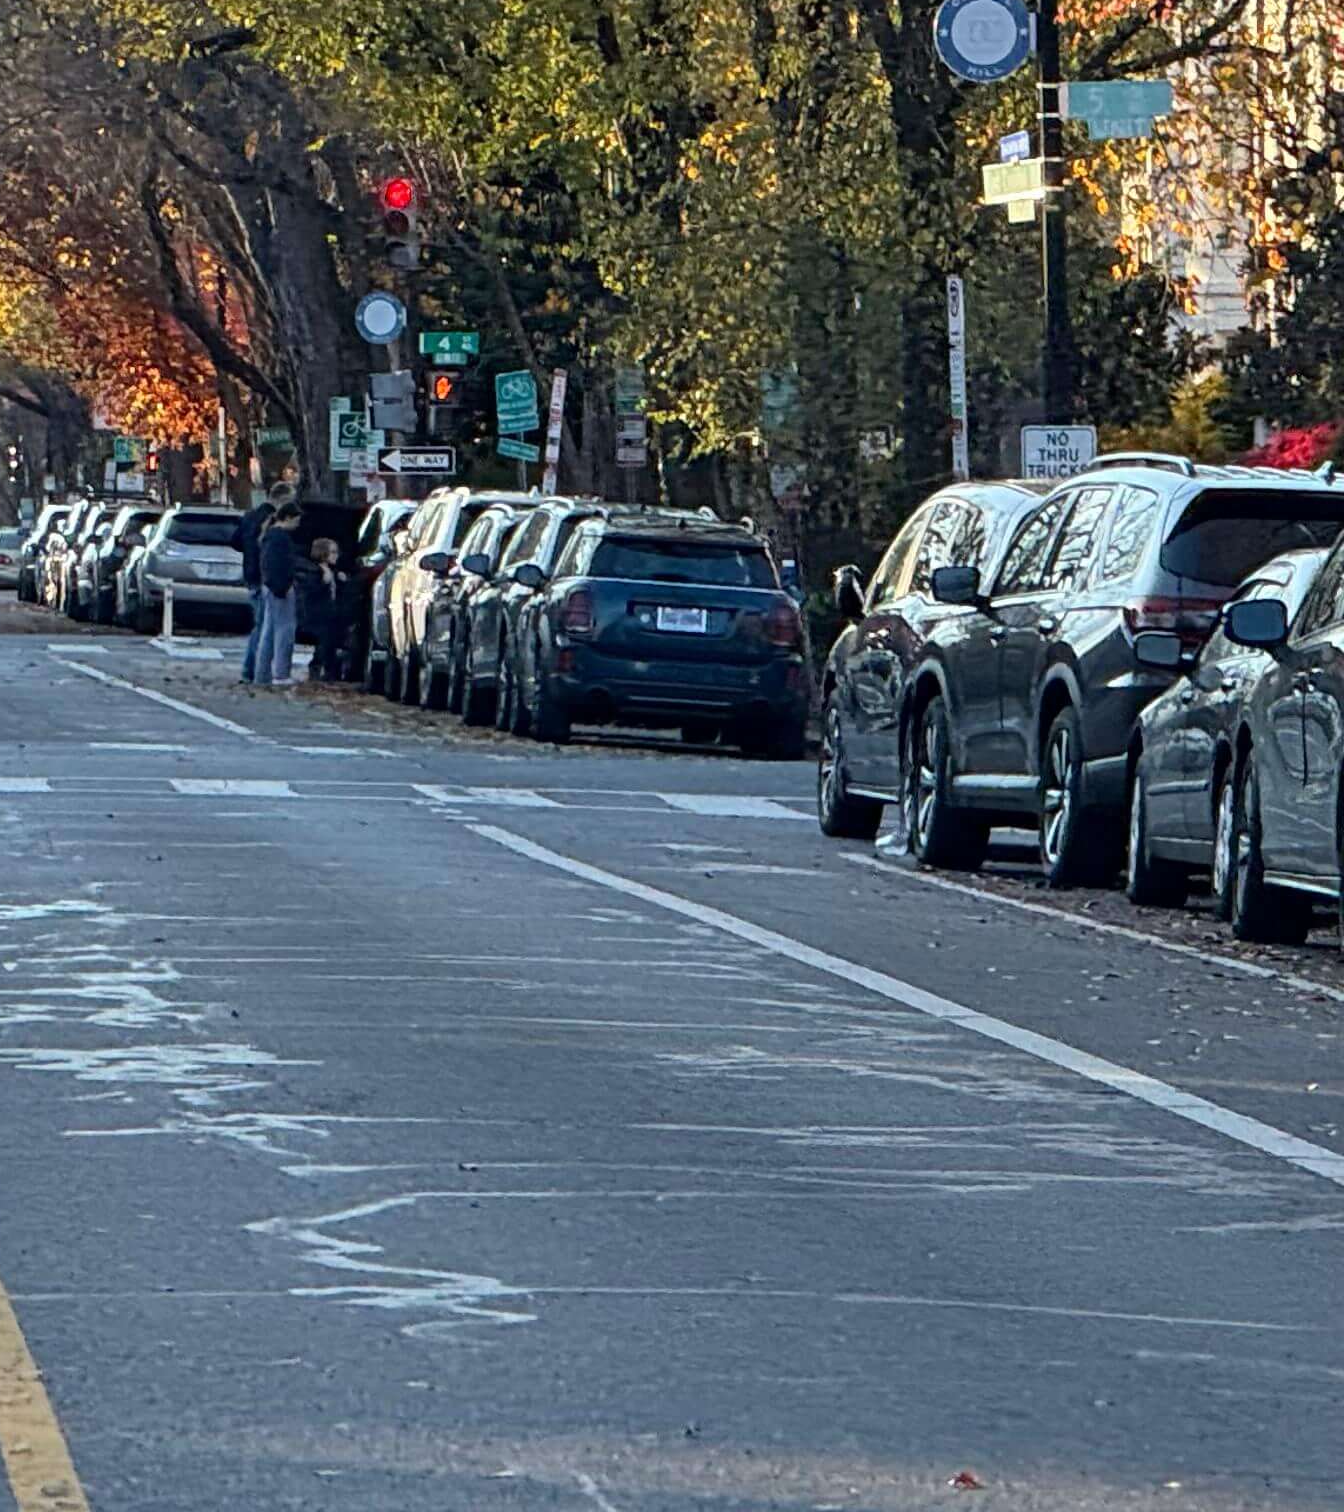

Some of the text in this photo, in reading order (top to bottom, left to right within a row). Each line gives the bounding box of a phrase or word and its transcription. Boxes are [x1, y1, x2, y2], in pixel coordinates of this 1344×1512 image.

[438, 336, 450, 351] 4
[1046, 431, 1069, 446] NO
[400, 455, 445, 465] ONE WAY
[1038, 447, 1079, 462] THRU
